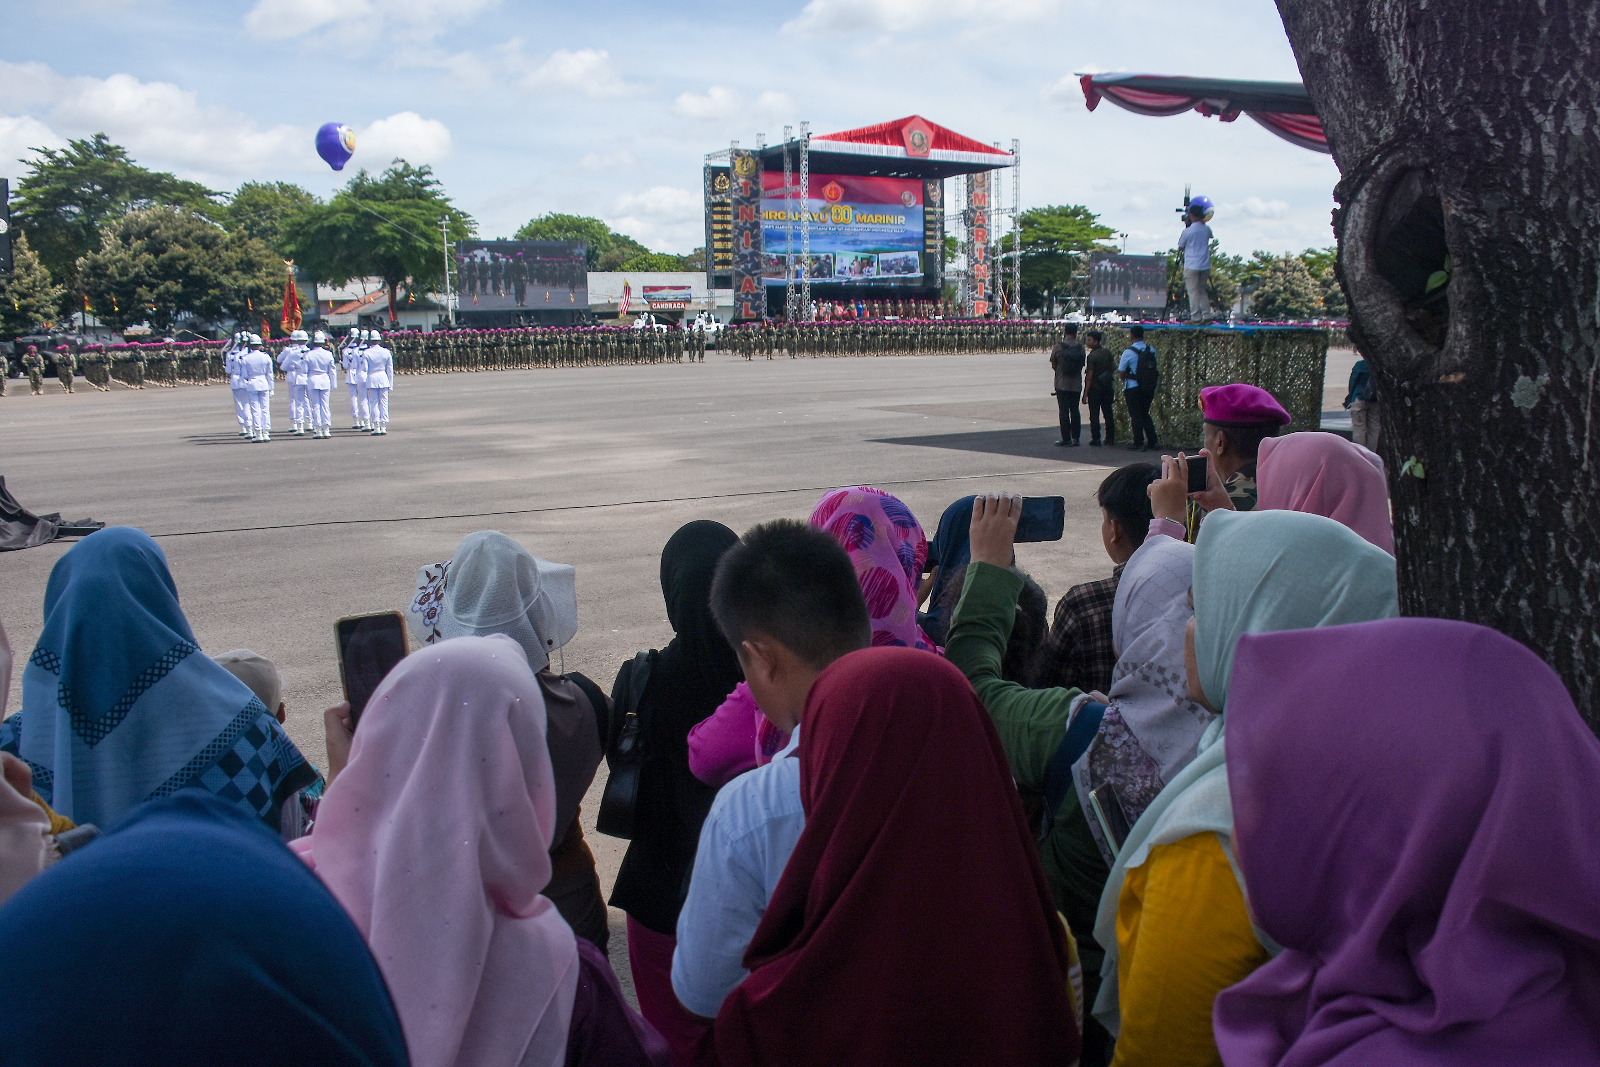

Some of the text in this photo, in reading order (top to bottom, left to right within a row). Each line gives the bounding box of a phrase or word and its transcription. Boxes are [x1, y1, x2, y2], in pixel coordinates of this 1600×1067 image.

[831, 204, 853, 224] 80
[856, 213, 906, 225] MARINIR
[973, 191, 988, 315] MARINIR
